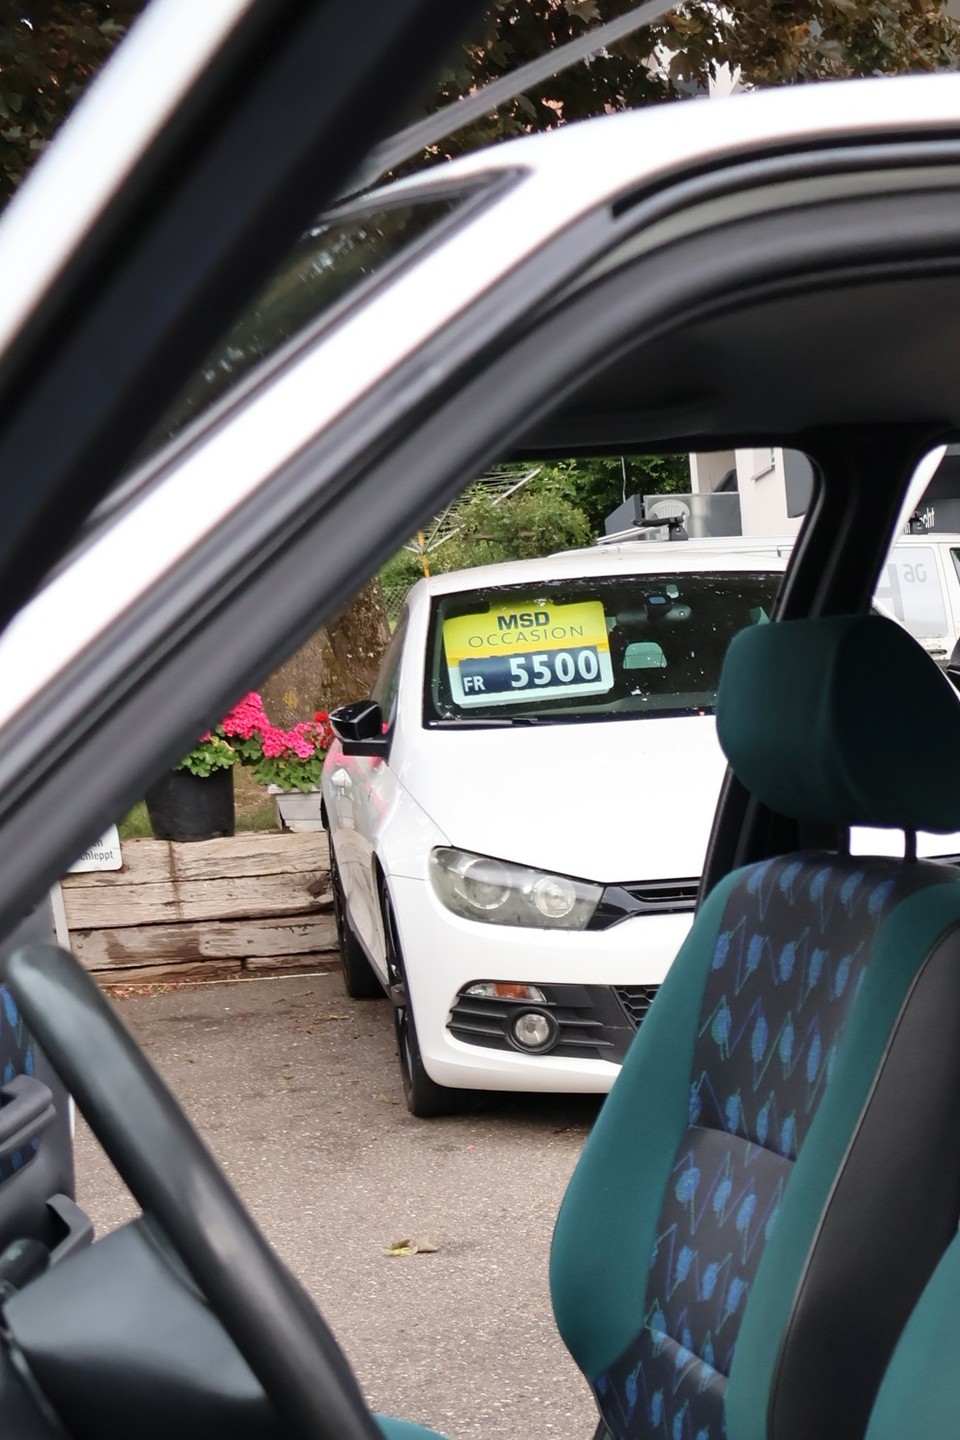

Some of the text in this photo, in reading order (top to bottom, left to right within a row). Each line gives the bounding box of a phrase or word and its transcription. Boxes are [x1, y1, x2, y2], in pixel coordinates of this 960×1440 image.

[497, 611, 550, 631] MSD
[468, 625, 584, 648] OCCASION
[463, 649, 598, 692] FR 5500
